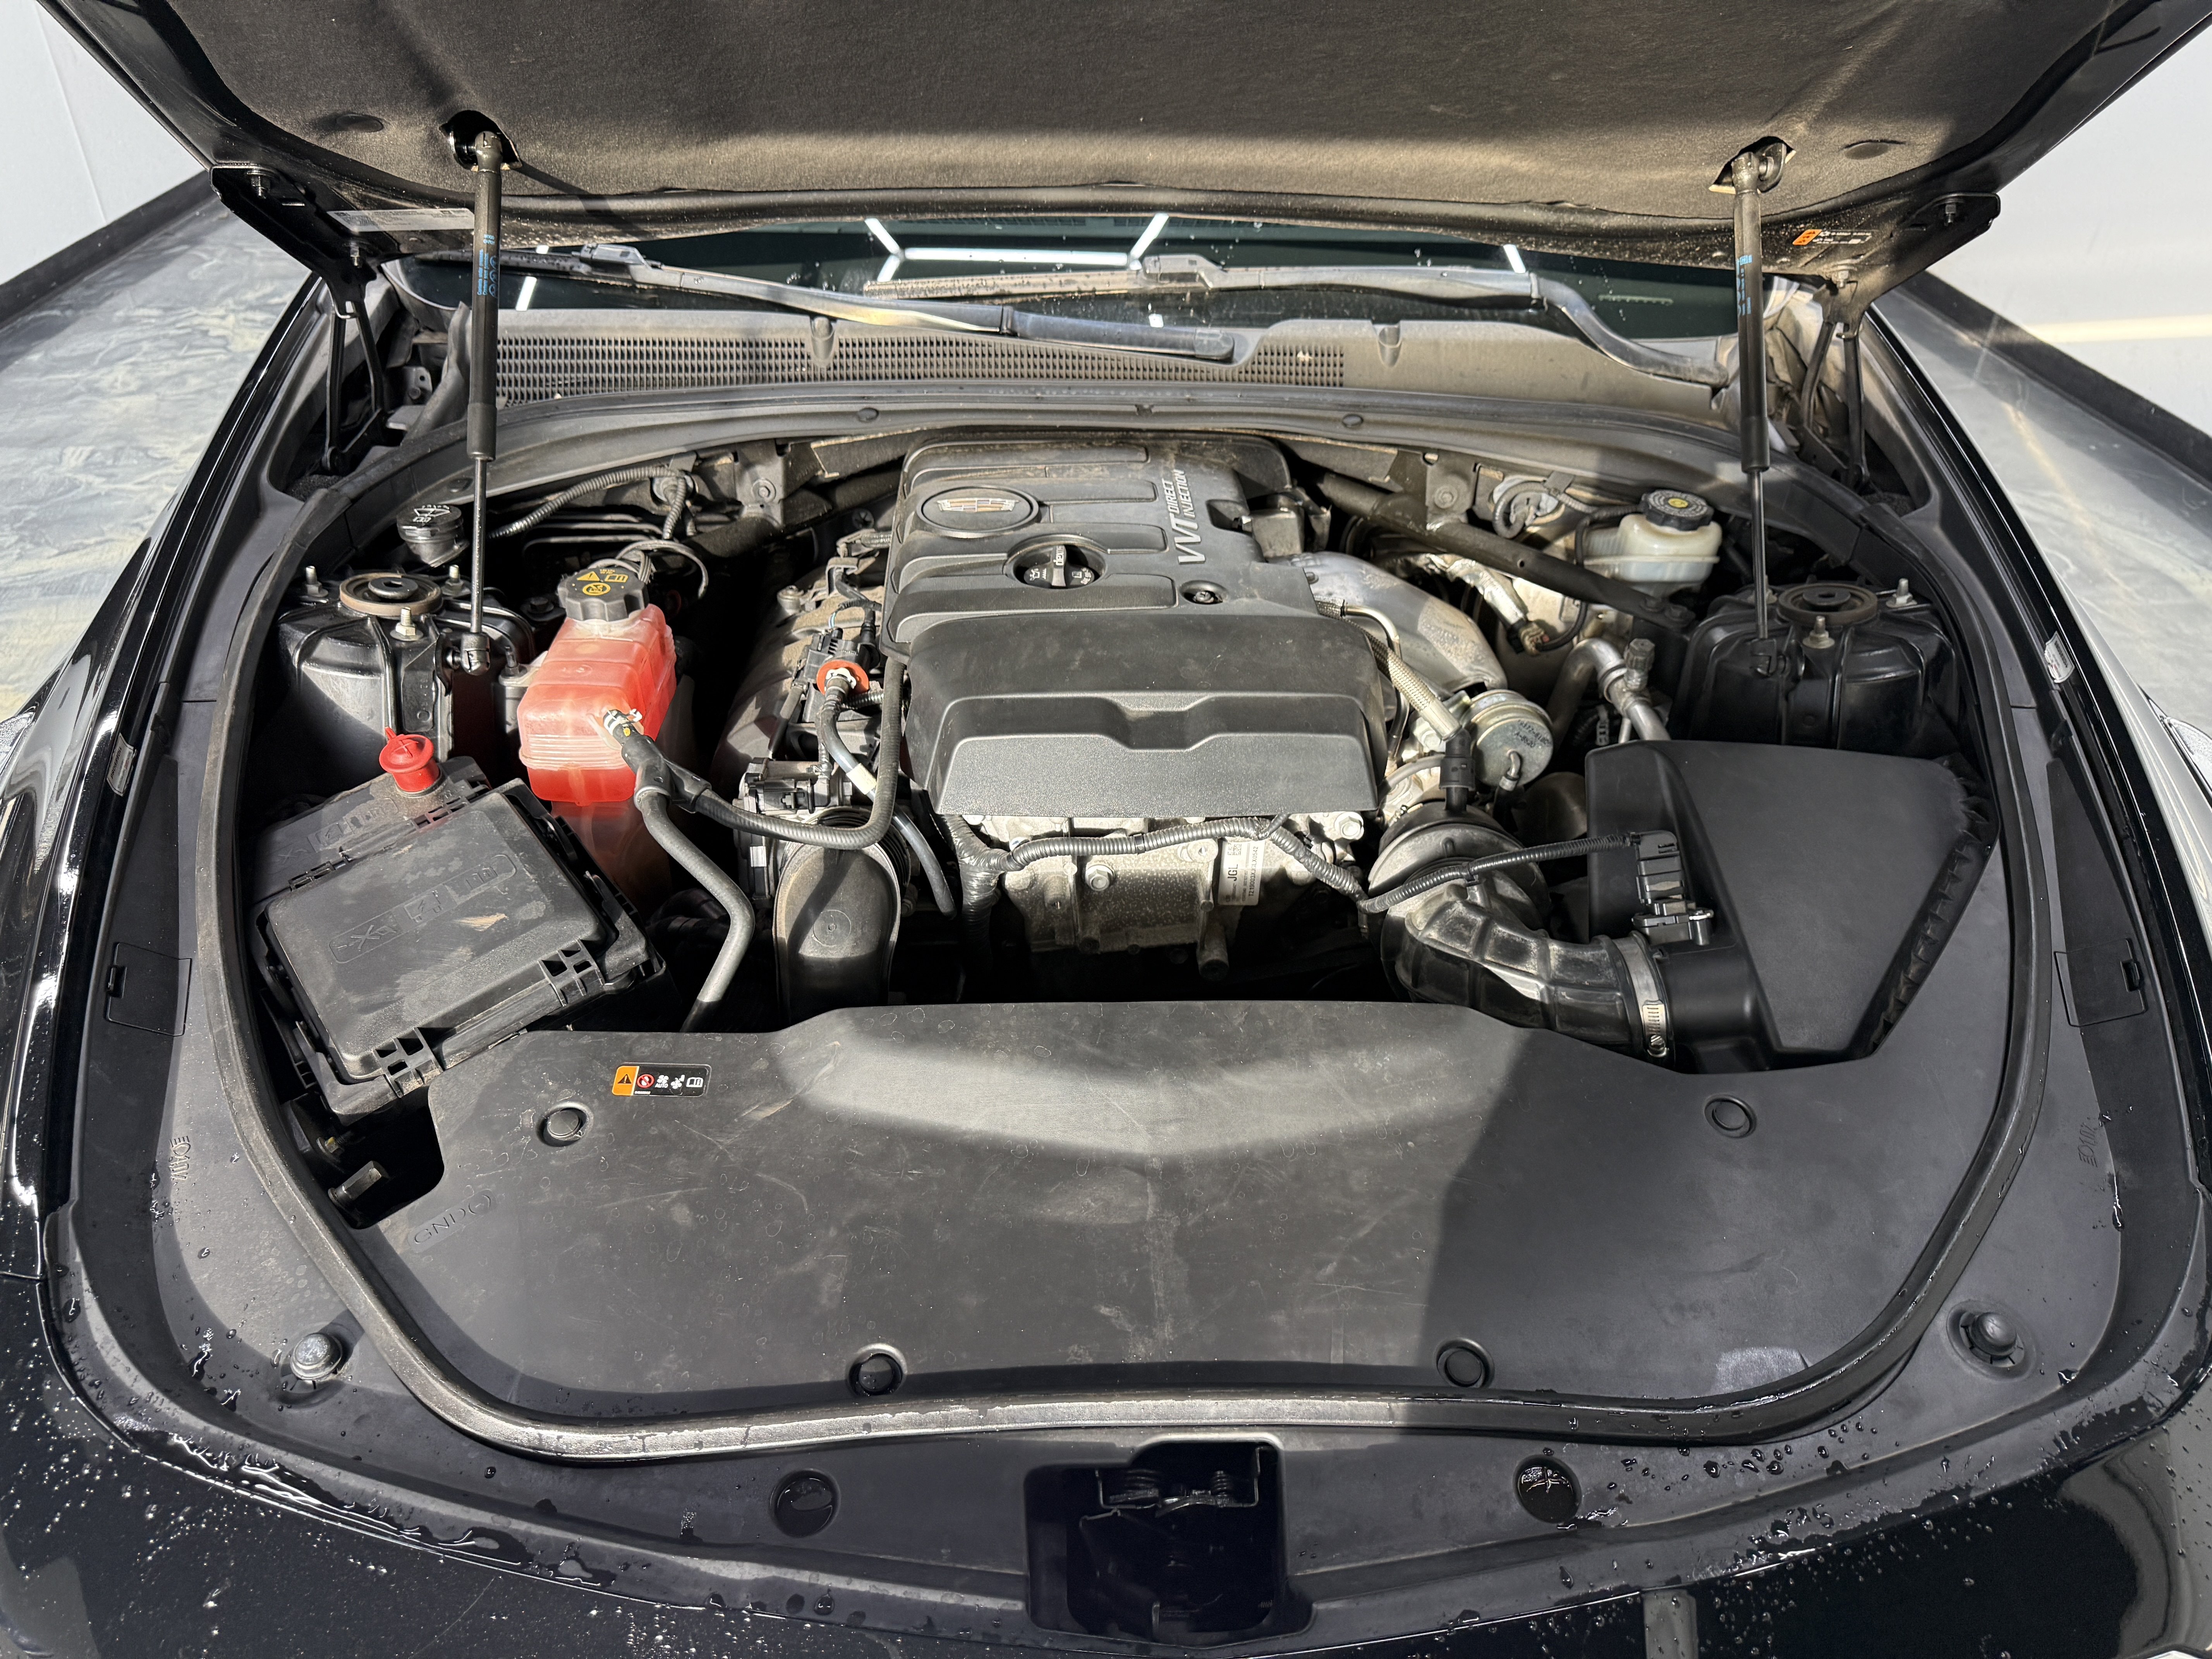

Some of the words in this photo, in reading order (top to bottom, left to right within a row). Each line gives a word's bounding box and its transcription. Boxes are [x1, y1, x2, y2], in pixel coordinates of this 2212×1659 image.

[1162, 478, 1180, 515] DIRECT
[1173, 469, 1195, 519] INJECTION
[1170, 513, 1206, 565] VVT
[1227, 864, 1238, 881] JGL
